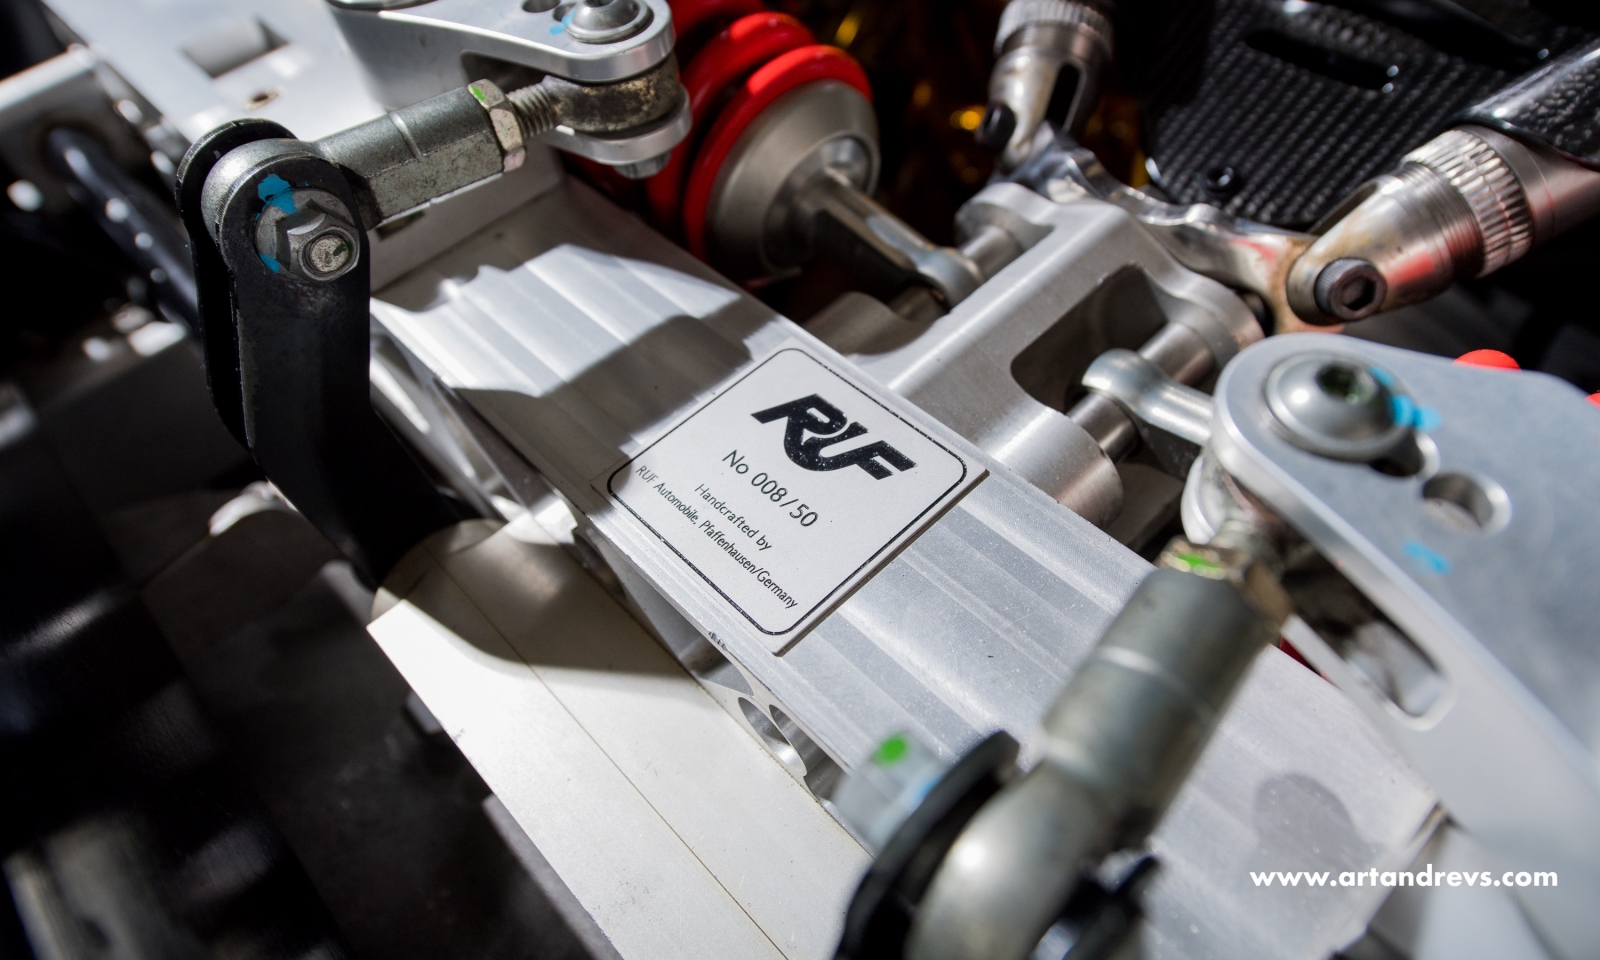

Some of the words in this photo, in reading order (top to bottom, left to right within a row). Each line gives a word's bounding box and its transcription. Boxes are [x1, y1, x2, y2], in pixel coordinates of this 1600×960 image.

[722, 449, 748, 475] No
[751, 393, 918, 480] RUF
[635, 465, 658, 483] RUF
[653, 482, 699, 526] Automobile,
[698, 519, 798, 609] Pfaffenhausen/Germany
[694, 483, 759, 539] Handcrafted
[756, 534, 773, 551] by
